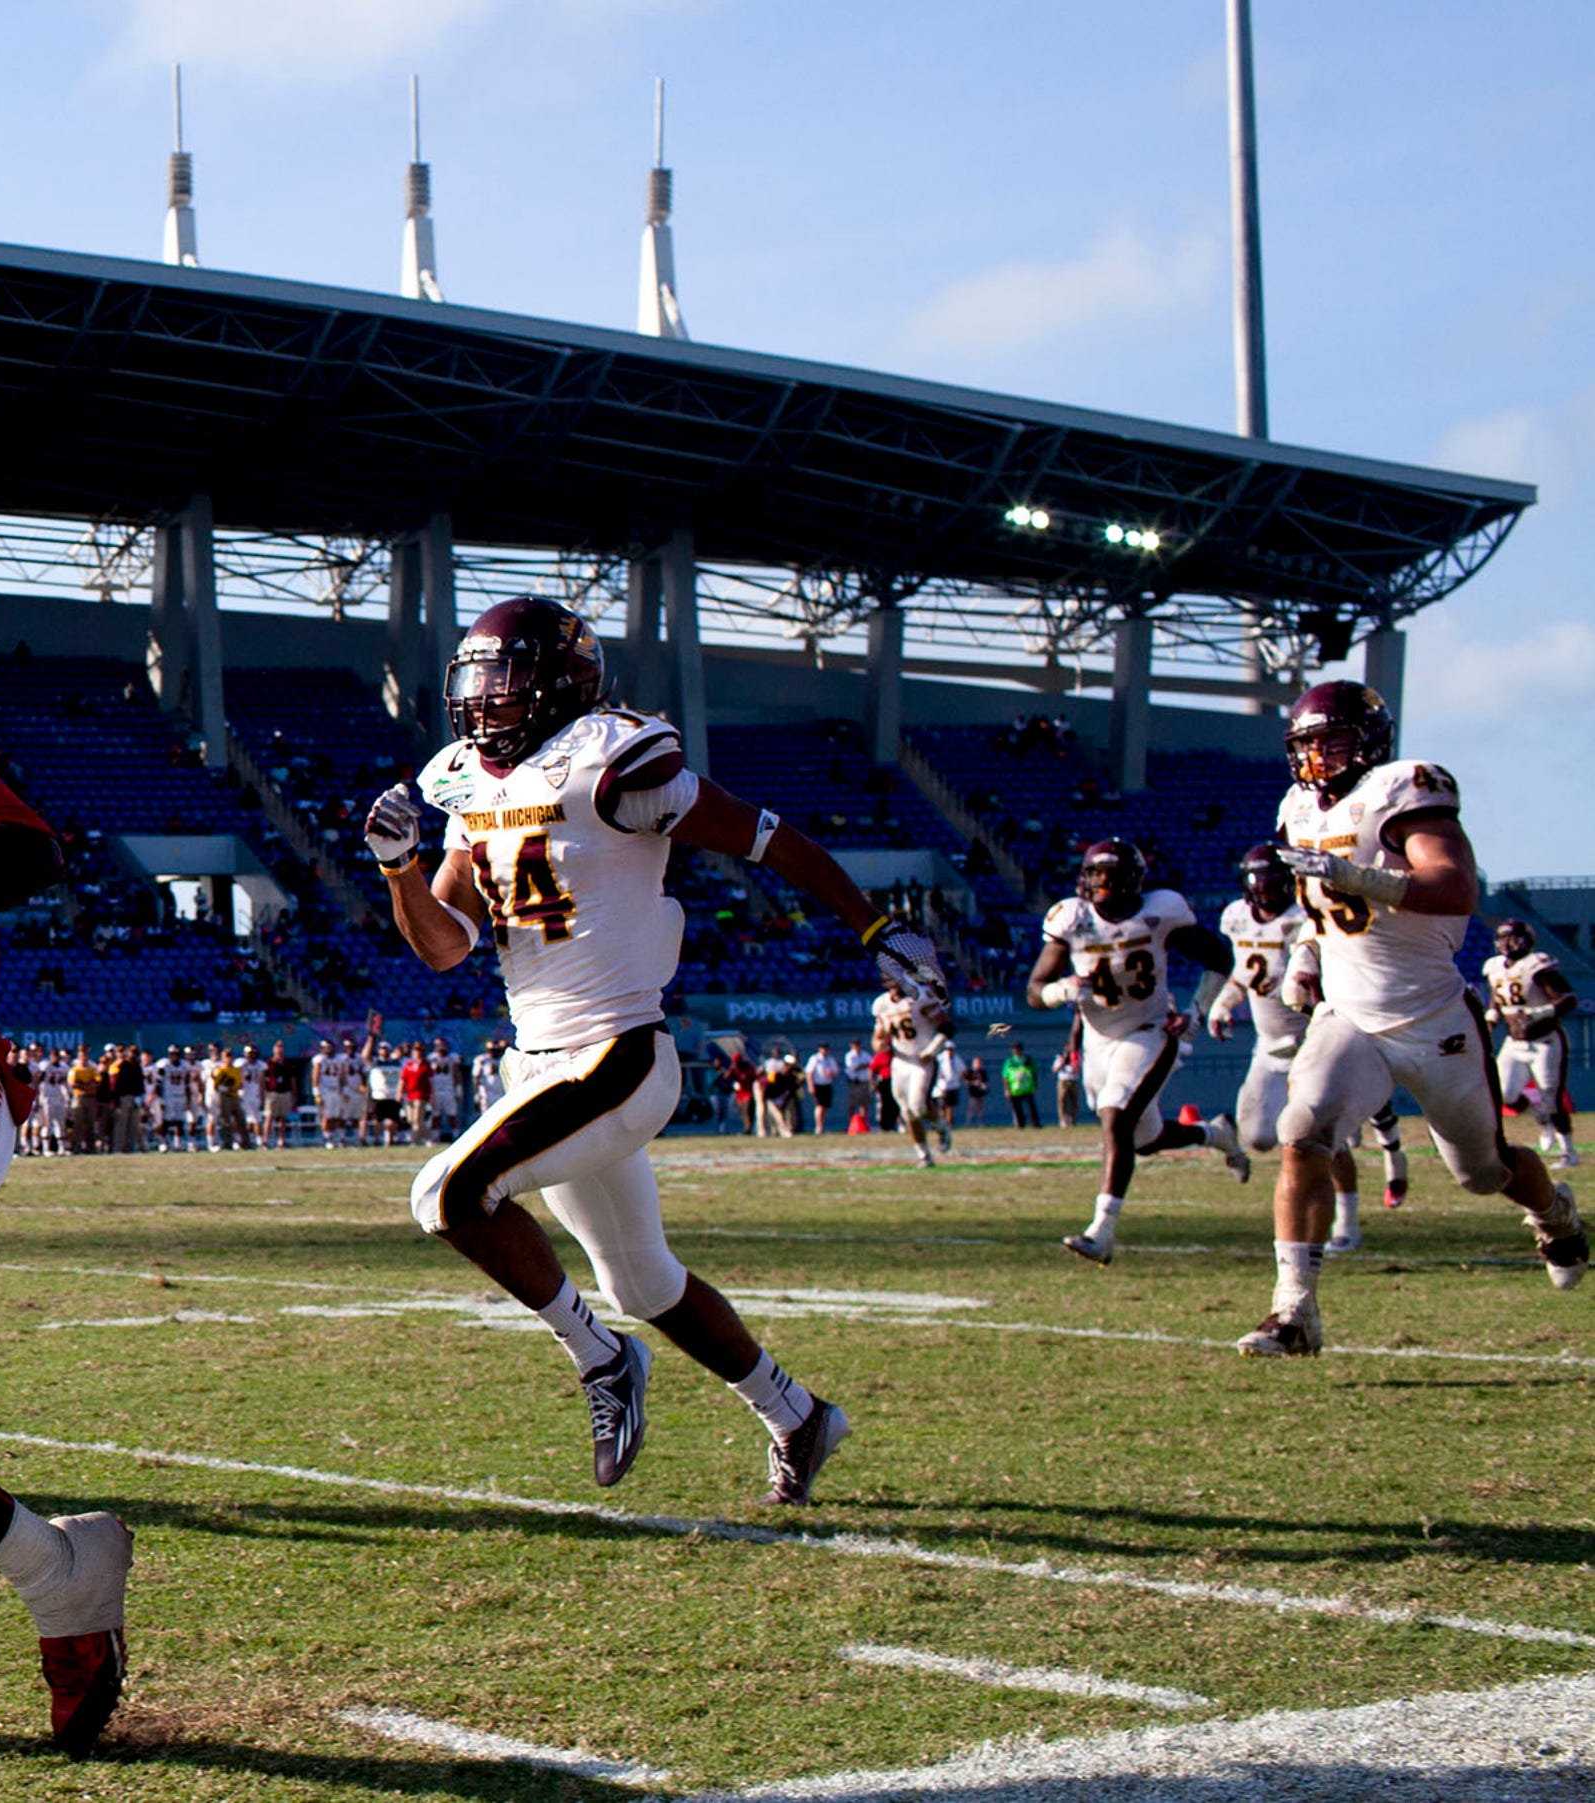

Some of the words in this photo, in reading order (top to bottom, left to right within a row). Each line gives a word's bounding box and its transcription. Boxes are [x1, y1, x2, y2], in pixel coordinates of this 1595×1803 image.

[502, 802, 567, 830] MICHIGAN
[470, 829, 577, 950] 14
[1091, 949, 1157, 1009] 43
[1246, 953, 1280, 998] 2
